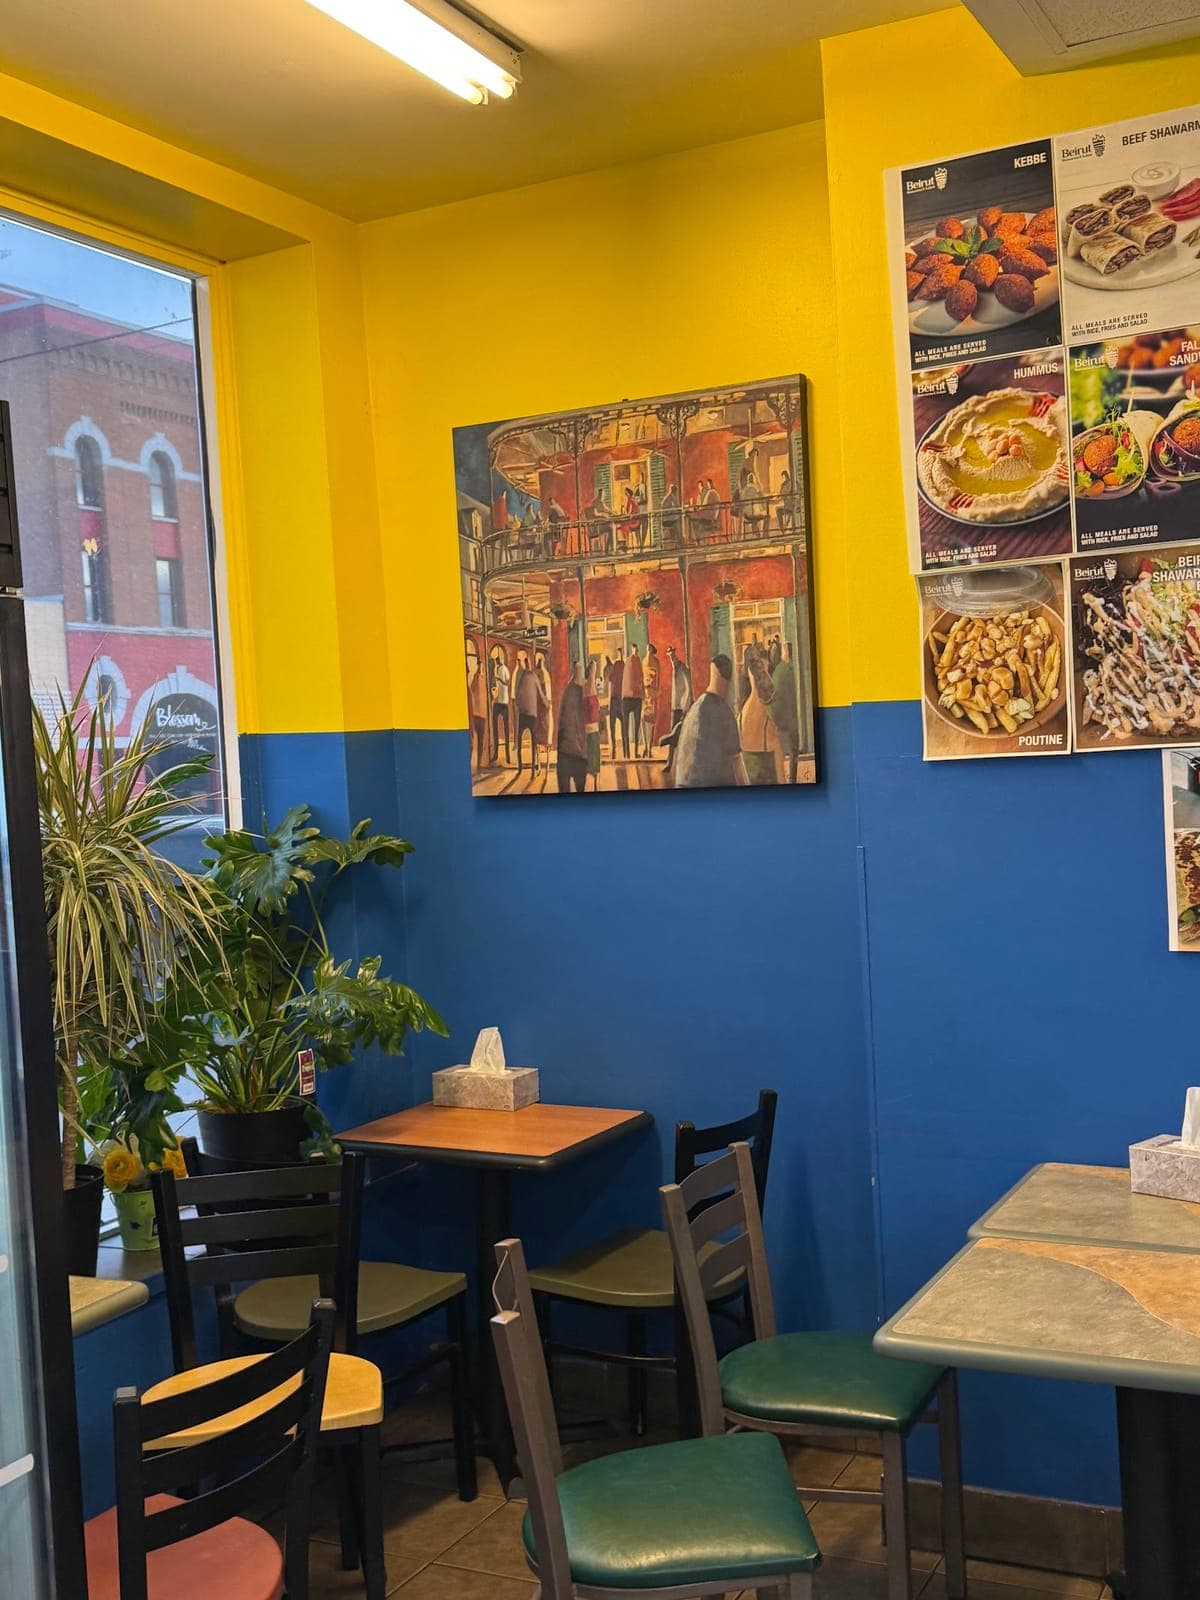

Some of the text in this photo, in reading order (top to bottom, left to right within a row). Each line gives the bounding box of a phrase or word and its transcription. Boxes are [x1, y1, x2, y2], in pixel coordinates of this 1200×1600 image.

[1122, 131, 1148, 146] BEEF
[1061, 144, 1092, 158] Beirut
[1014, 152, 1047, 169] KEBBE
[906, 176, 935, 191] Beirut
[1071, 329, 1086, 337] WITH
[1101, 324, 1117, 332] FRIES
[1117, 322, 1129, 330] AND
[1129, 318, 1148, 327] SALAD
[1085, 319, 1107, 328] MEALS
[1108, 316, 1121, 324] ARE
[1123, 312, 1148, 322] SERVED
[914, 355, 928, 363] WITH
[957, 348, 969, 356] AND
[969, 345, 987, 354] SALAD
[927, 346, 948, 355] MEALS
[949, 343, 961, 351] ARE
[963, 339, 987, 348] SERVED
[1074, 355, 1105, 368] Beirut
[1169, 351, 1200, 366] SAND
[1014, 362, 1059, 379] HUMMUS
[917, 381, 946, 394] Beirut
[1081, 538, 1096, 546] WITH
[1111, 534, 1127, 542] FRIES
[1139, 531, 1158, 539] SALAD
[1095, 529, 1117, 538] MEALS
[1118, 527, 1131, 535] ARE
[1133, 524, 1158, 533] SERVED
[938, 548, 959, 557] MEALS
[979, 549, 997, 557] SALAD
[1074, 566, 1104, 578] Beirut
[1152, 567, 1200, 583] SHAWAR
[924, 583, 953, 594] Beirut
[1018, 734, 1063, 746] POUTINE
